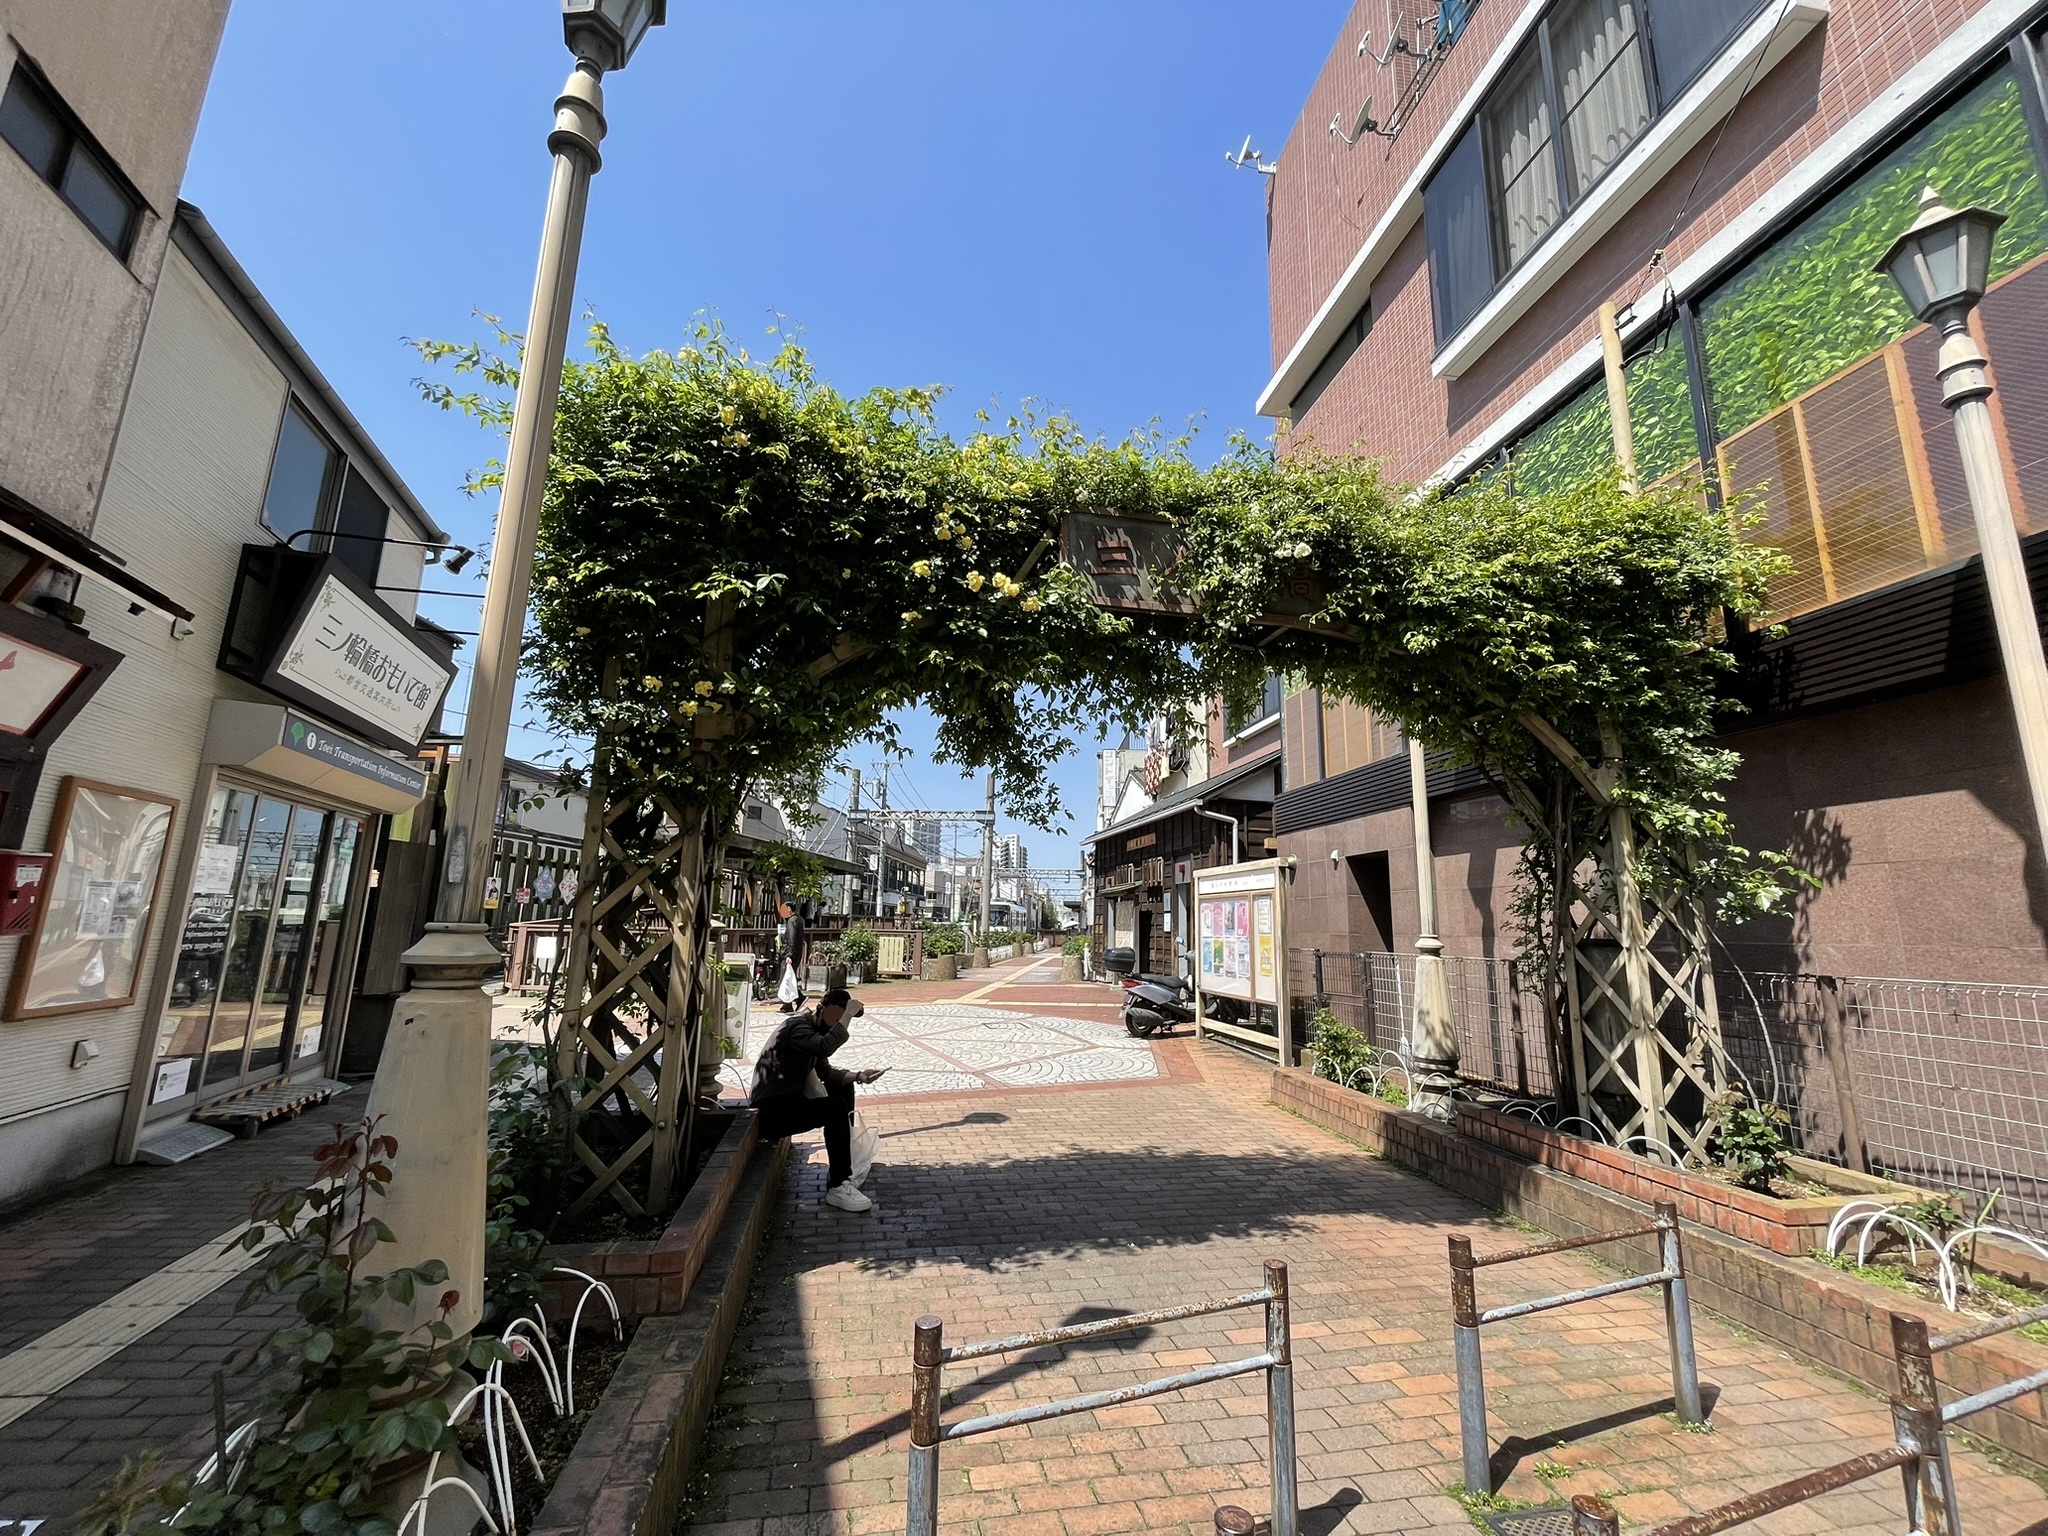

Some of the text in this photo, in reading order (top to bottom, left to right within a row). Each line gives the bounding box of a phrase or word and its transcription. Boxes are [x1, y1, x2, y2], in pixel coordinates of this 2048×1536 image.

[315, 614, 432, 711] 三ノ輪橋おもいで館
[318, 739, 422, 790] Toei Transportation Information Center
